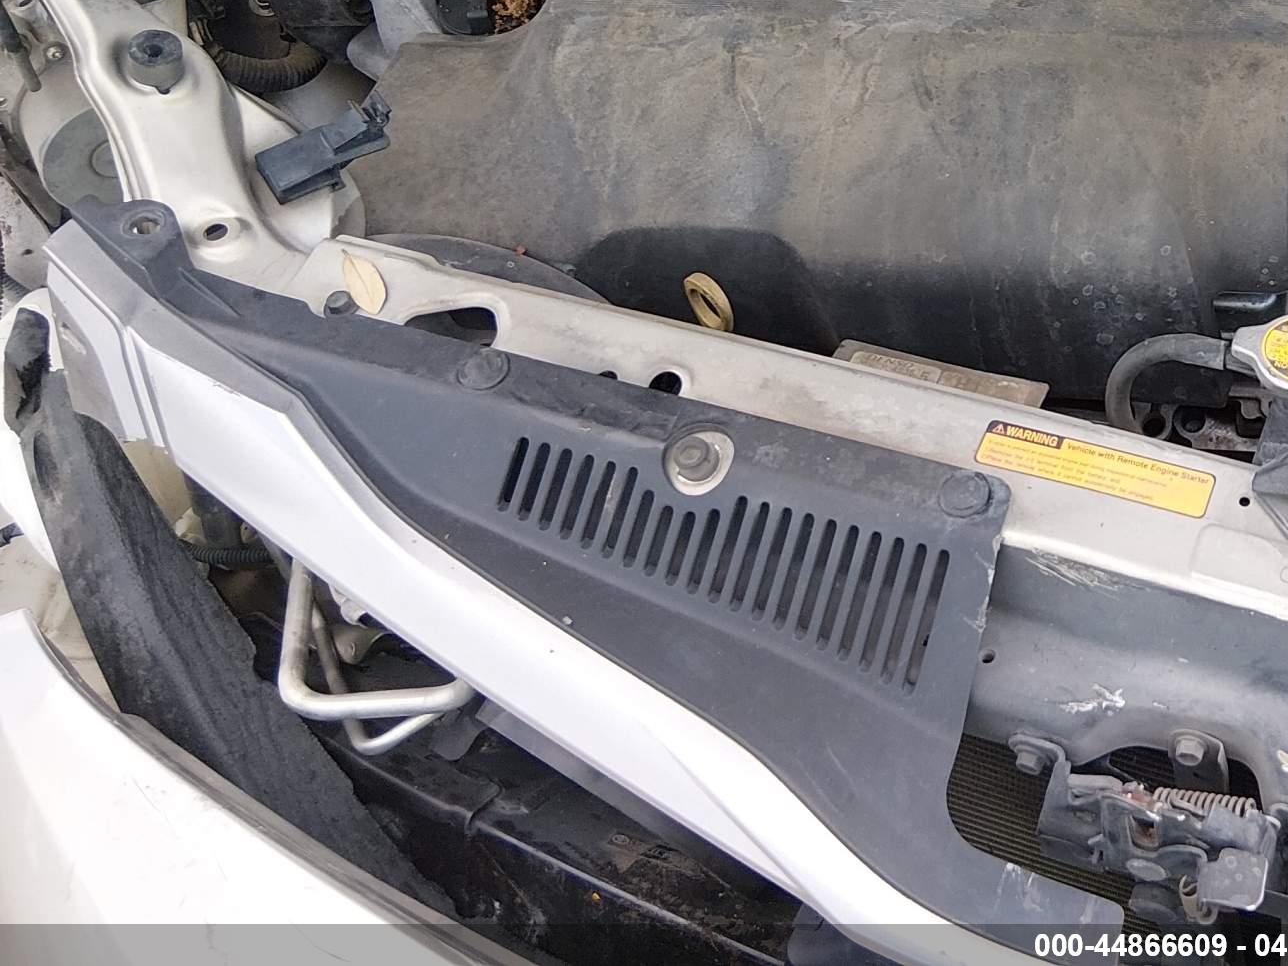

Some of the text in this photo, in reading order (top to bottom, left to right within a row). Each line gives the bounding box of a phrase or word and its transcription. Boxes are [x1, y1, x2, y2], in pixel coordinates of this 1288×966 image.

[1006, 425, 1058, 447] WARNING
[1067, 442, 1210, 485] Vehicle with Remote Engine Starter
